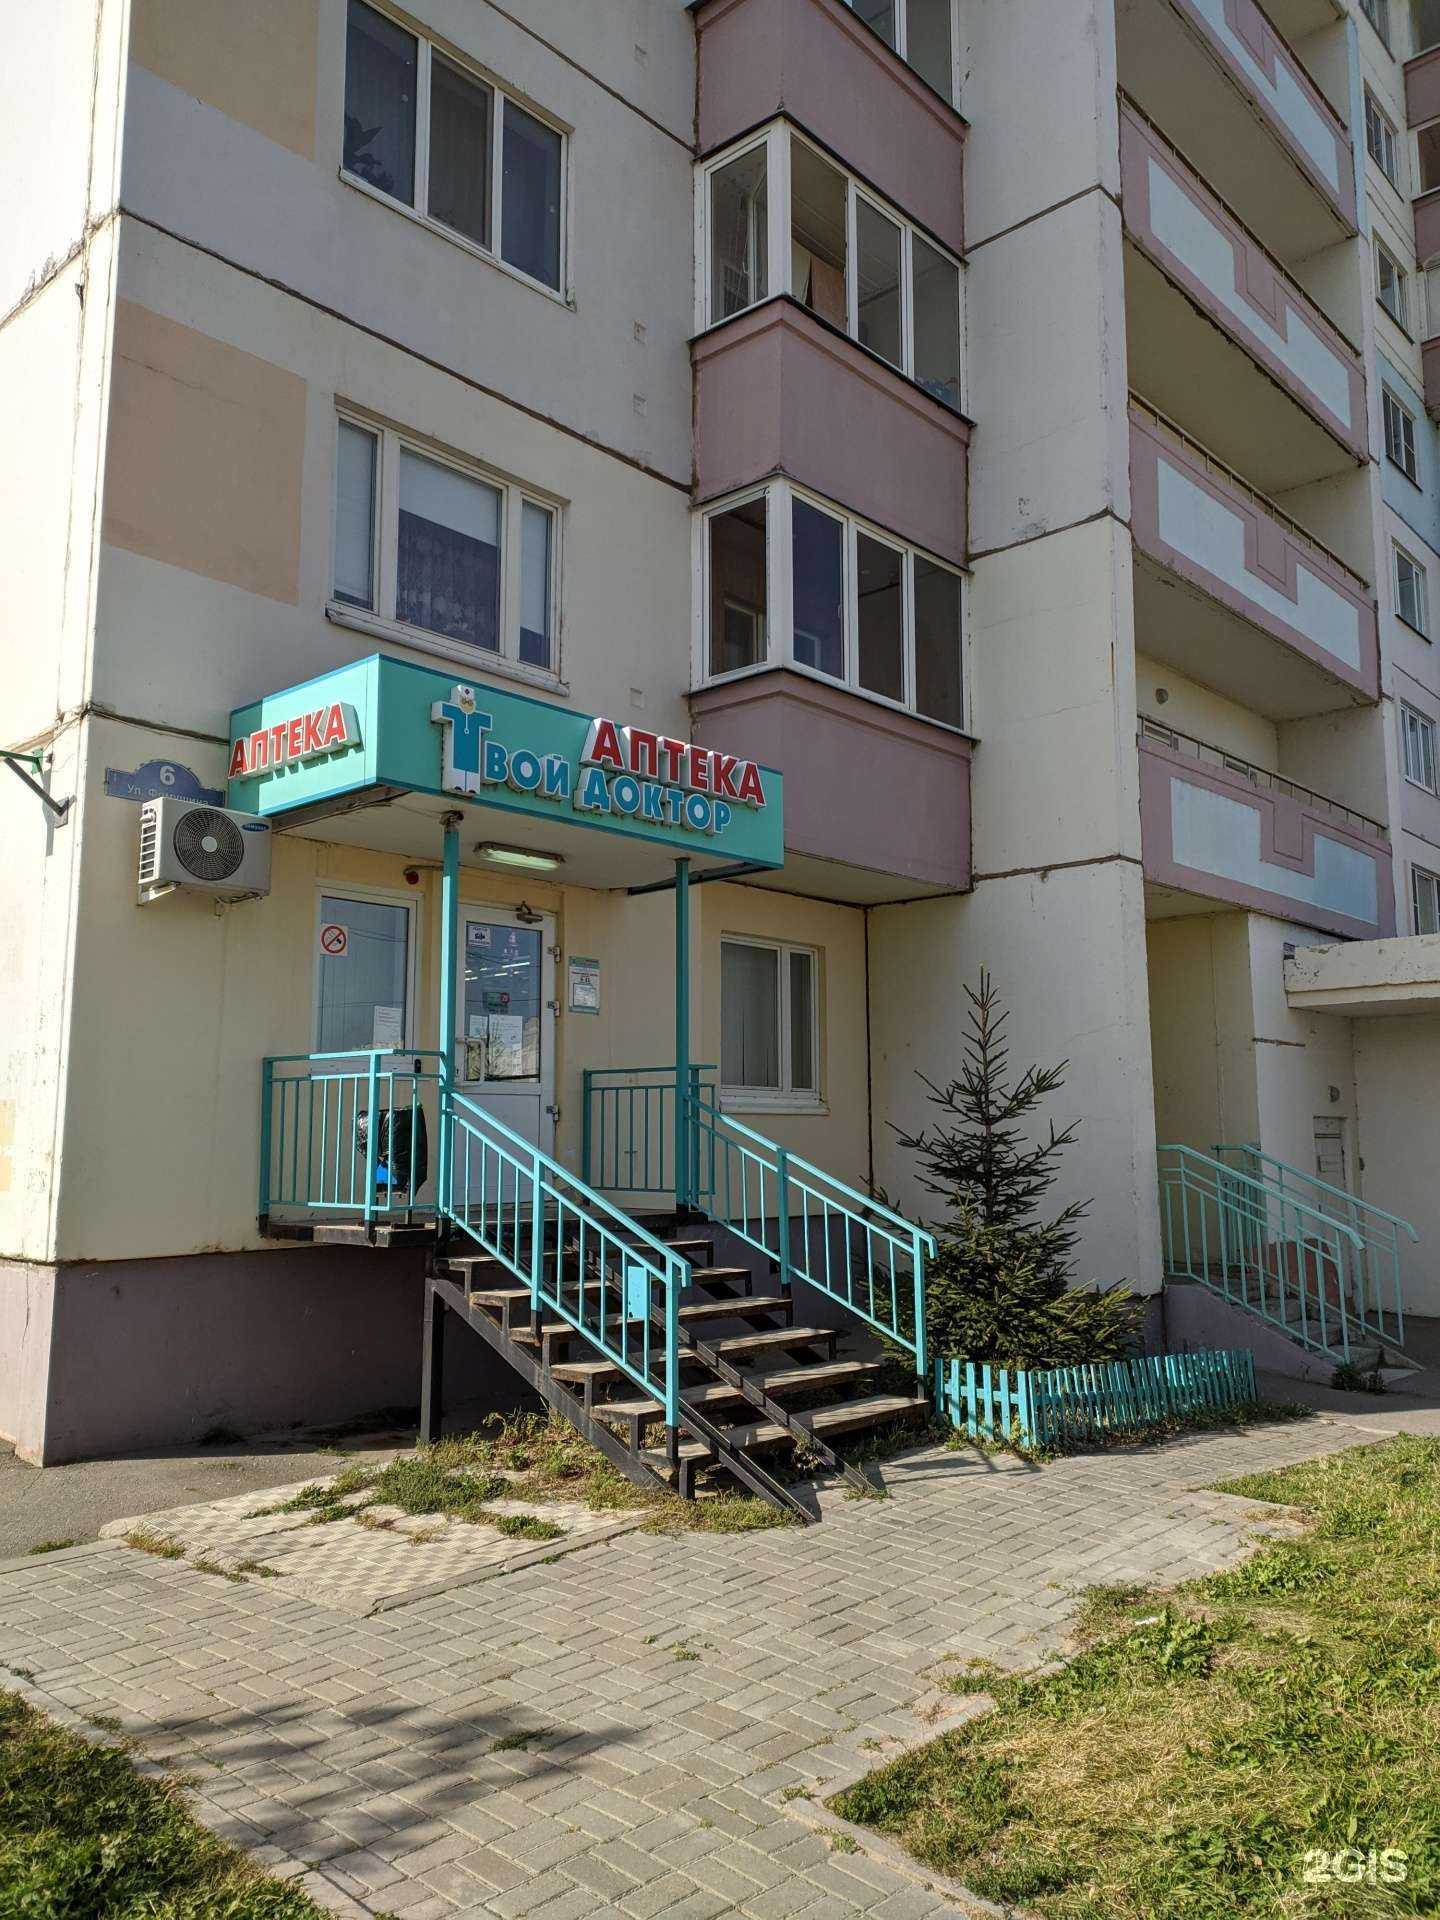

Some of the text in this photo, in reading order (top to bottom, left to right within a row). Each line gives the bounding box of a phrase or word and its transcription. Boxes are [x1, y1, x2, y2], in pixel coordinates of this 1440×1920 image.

[159, 765, 176, 786] 6
[228, 701, 347, 779] АПТЕКА
[588, 718, 767, 807] АПТЕКА
[581, 768, 732, 834] ДОКТОР
